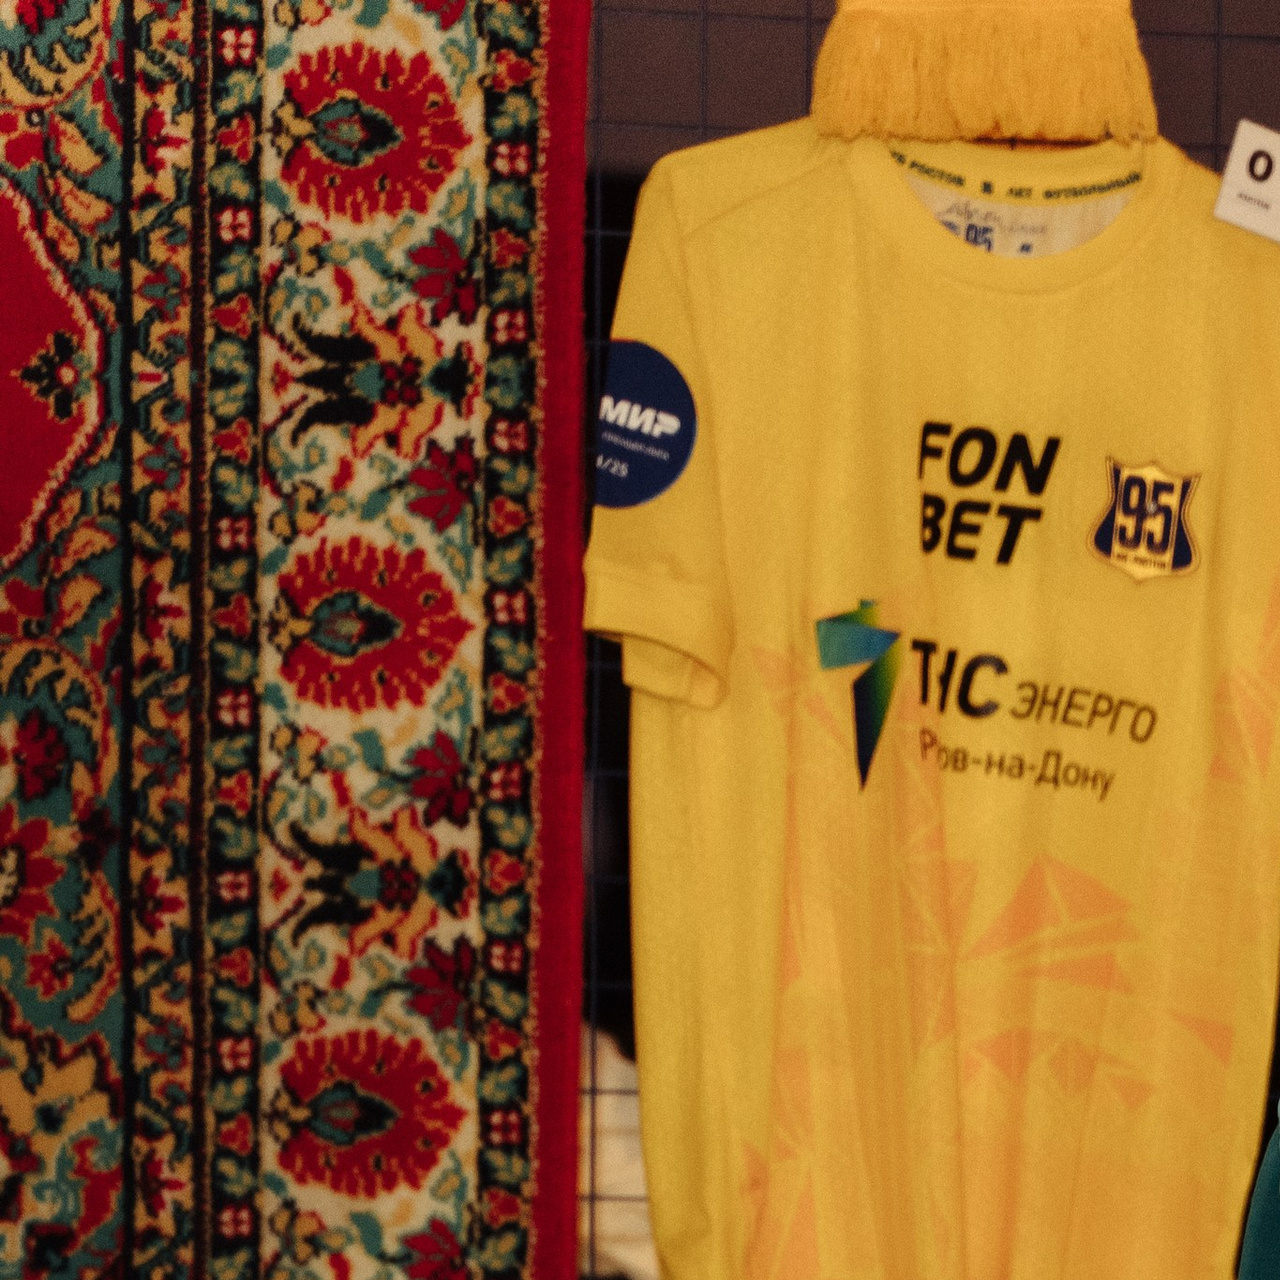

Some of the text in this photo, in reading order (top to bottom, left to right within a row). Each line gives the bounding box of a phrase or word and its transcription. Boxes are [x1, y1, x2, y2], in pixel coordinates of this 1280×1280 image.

[1248, 149, 1275, 183] 0
[599, 394, 682, 439] МИР
[918, 420, 1062, 497] FON
[920, 491, 1043, 566] BET
[1117, 474, 1176, 556] 95
[1010, 680, 1159, 744] ЭНЕРГО
